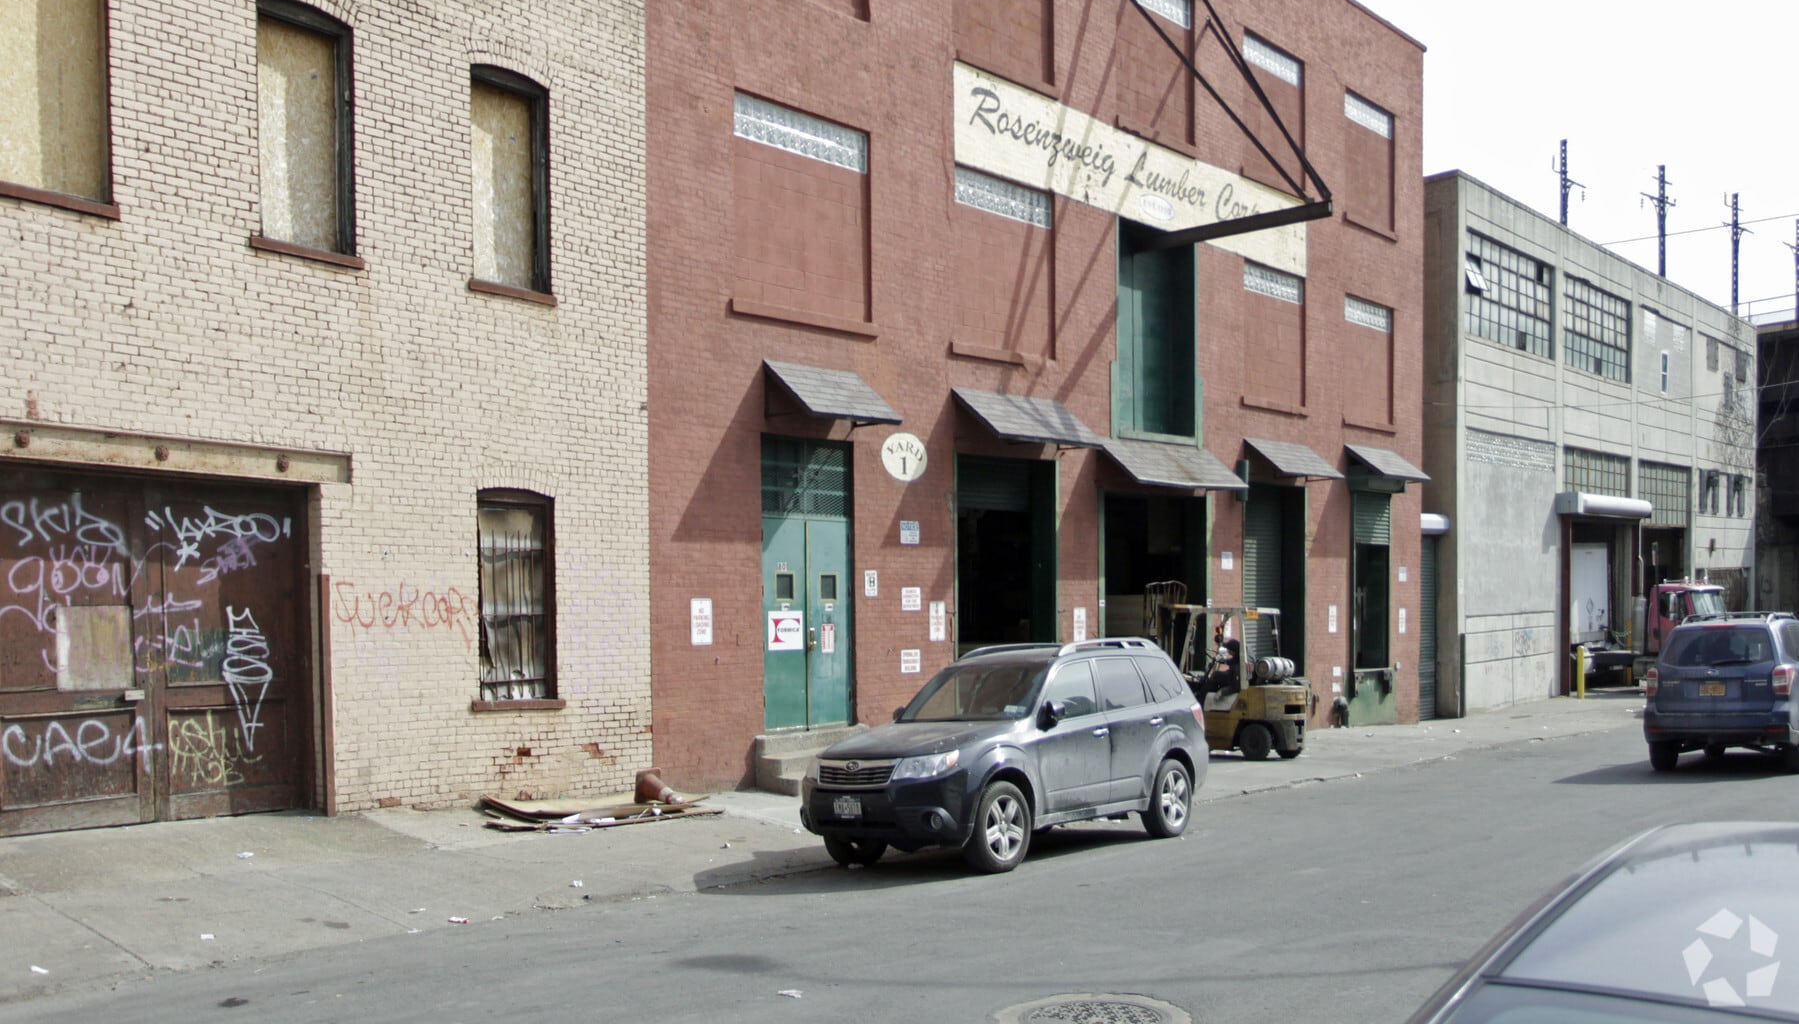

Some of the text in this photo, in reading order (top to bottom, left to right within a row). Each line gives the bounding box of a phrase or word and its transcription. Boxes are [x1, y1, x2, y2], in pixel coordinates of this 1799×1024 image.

[969, 87, 1116, 185] Rosenzweig
[1124, 151, 1206, 207] Lumber
[886, 439, 924, 462] YARD
[900, 456, 907, 475] 1
